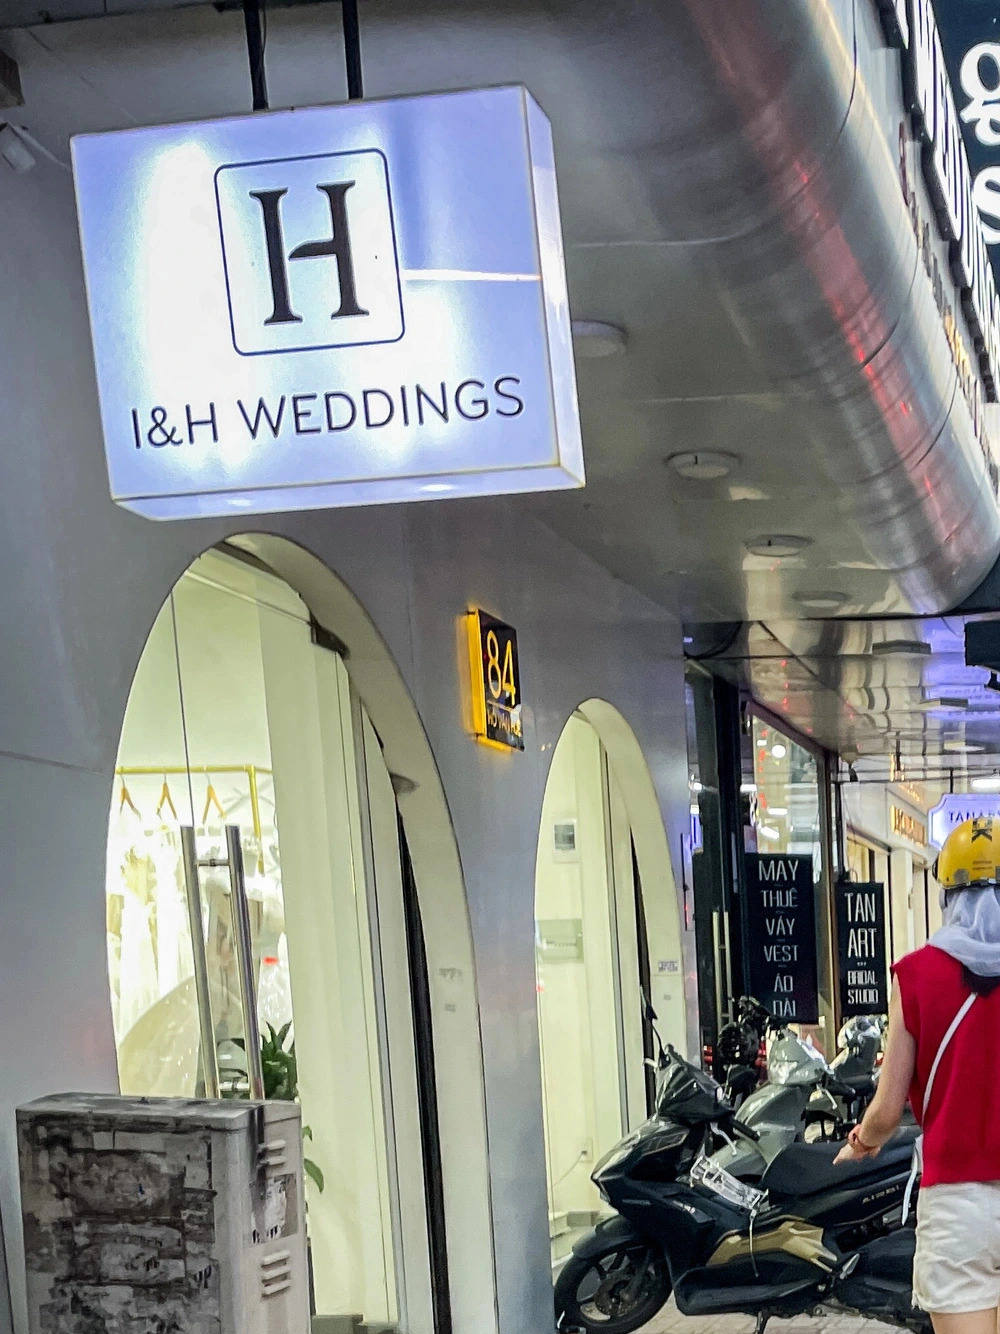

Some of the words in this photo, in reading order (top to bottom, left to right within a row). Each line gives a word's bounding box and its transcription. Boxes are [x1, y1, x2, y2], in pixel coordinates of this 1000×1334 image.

[131, 401, 219, 449] I&H
[237, 377, 525, 440] WEDDINGS
[487, 629, 516, 706] 84
[758, 860, 799, 882] MAY
[760, 887, 799, 908] THUÊ
[844, 892, 876, 923] TAN
[765, 915, 796, 937] VÁY
[763, 945, 798, 962] VEST
[847, 928, 877, 959] ART
[773, 973, 794, 993] ÁO
[847, 969, 878, 986] BRIDAL
[847, 988, 879, 1005] STUDIO
